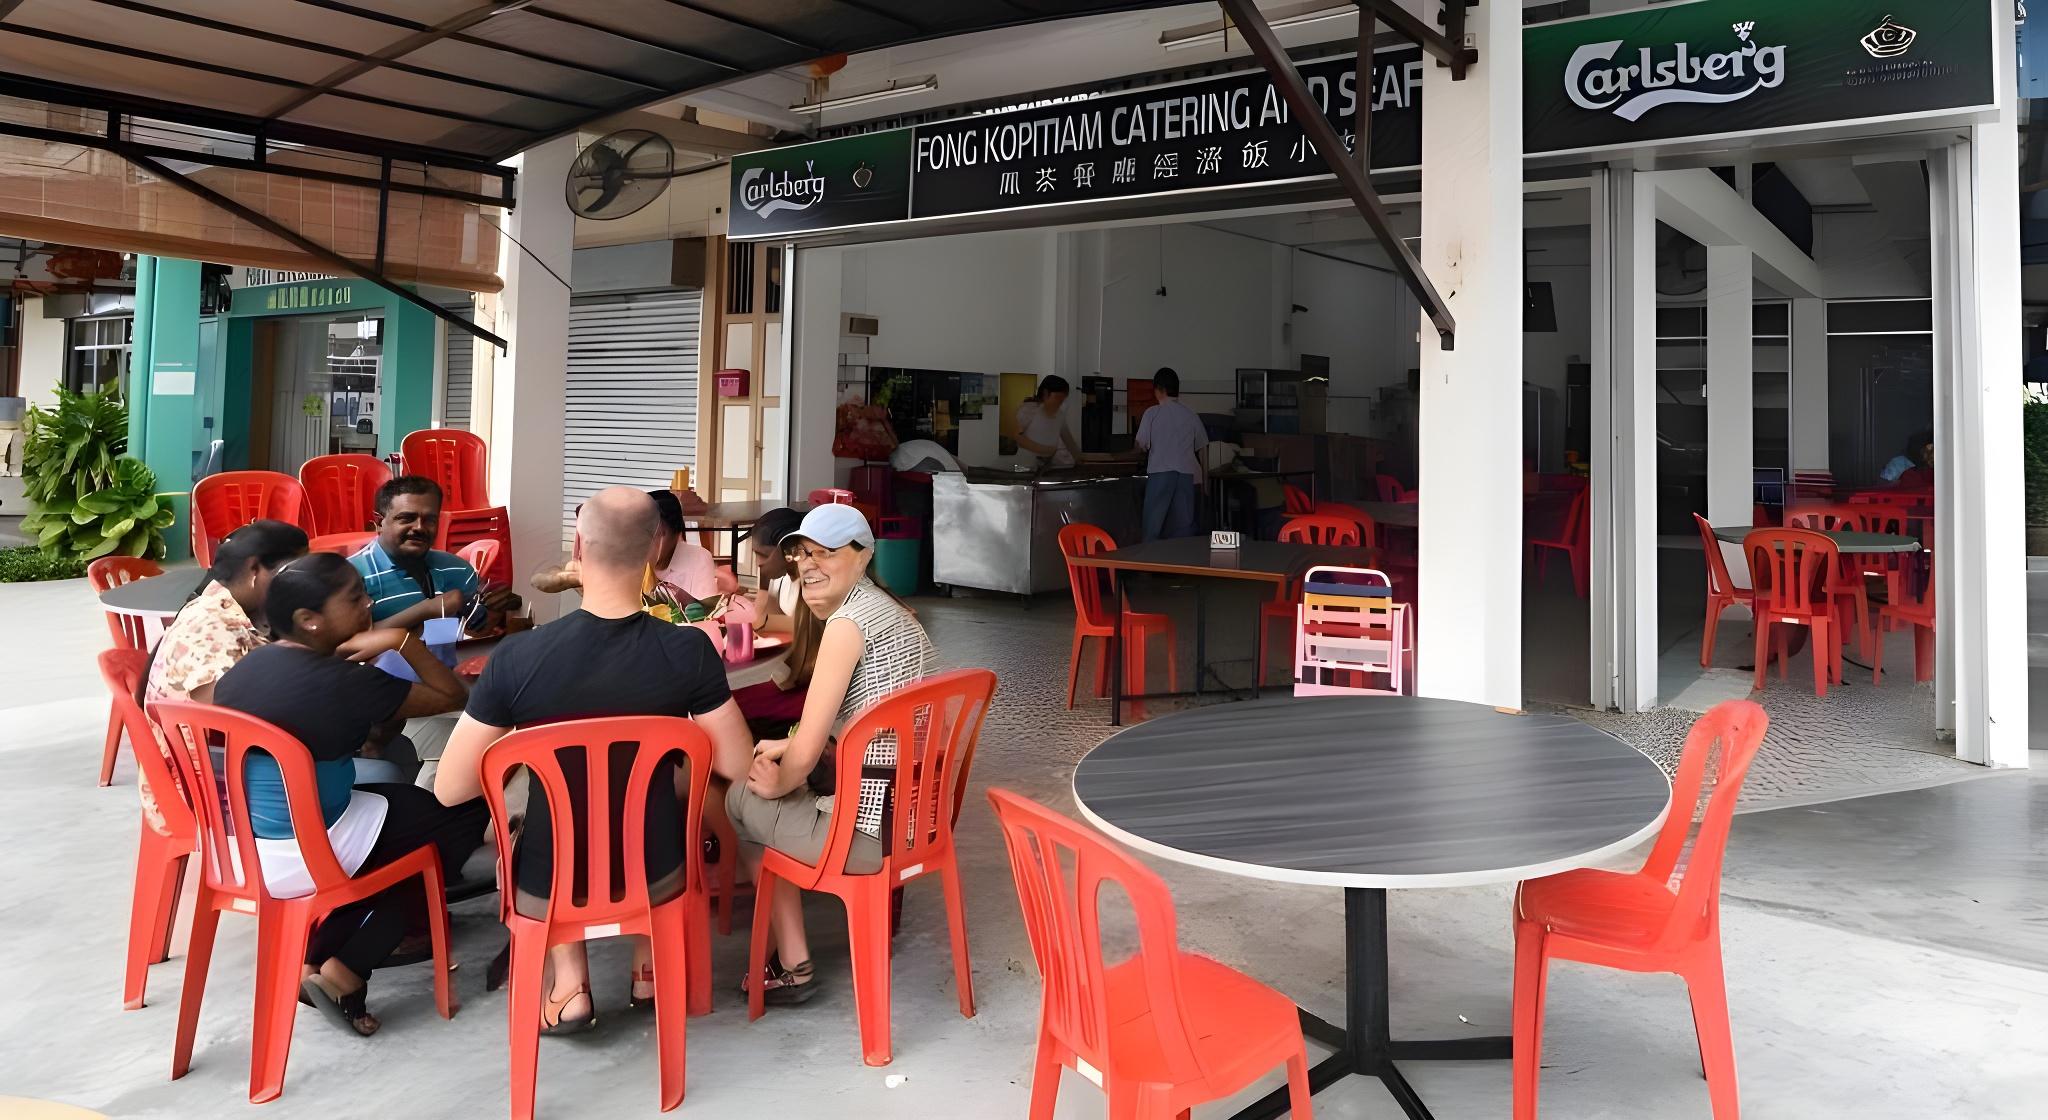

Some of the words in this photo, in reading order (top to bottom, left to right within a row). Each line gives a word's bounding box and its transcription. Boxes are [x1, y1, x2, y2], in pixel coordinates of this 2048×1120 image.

[1564, 39, 1787, 110] Carlsberg
[917, 129, 977, 173] FONG
[984, 110, 1103, 164] KOPITIAM
[1110, 87, 1250, 146] CATERING
[739, 163, 825, 211] Carlsberg
